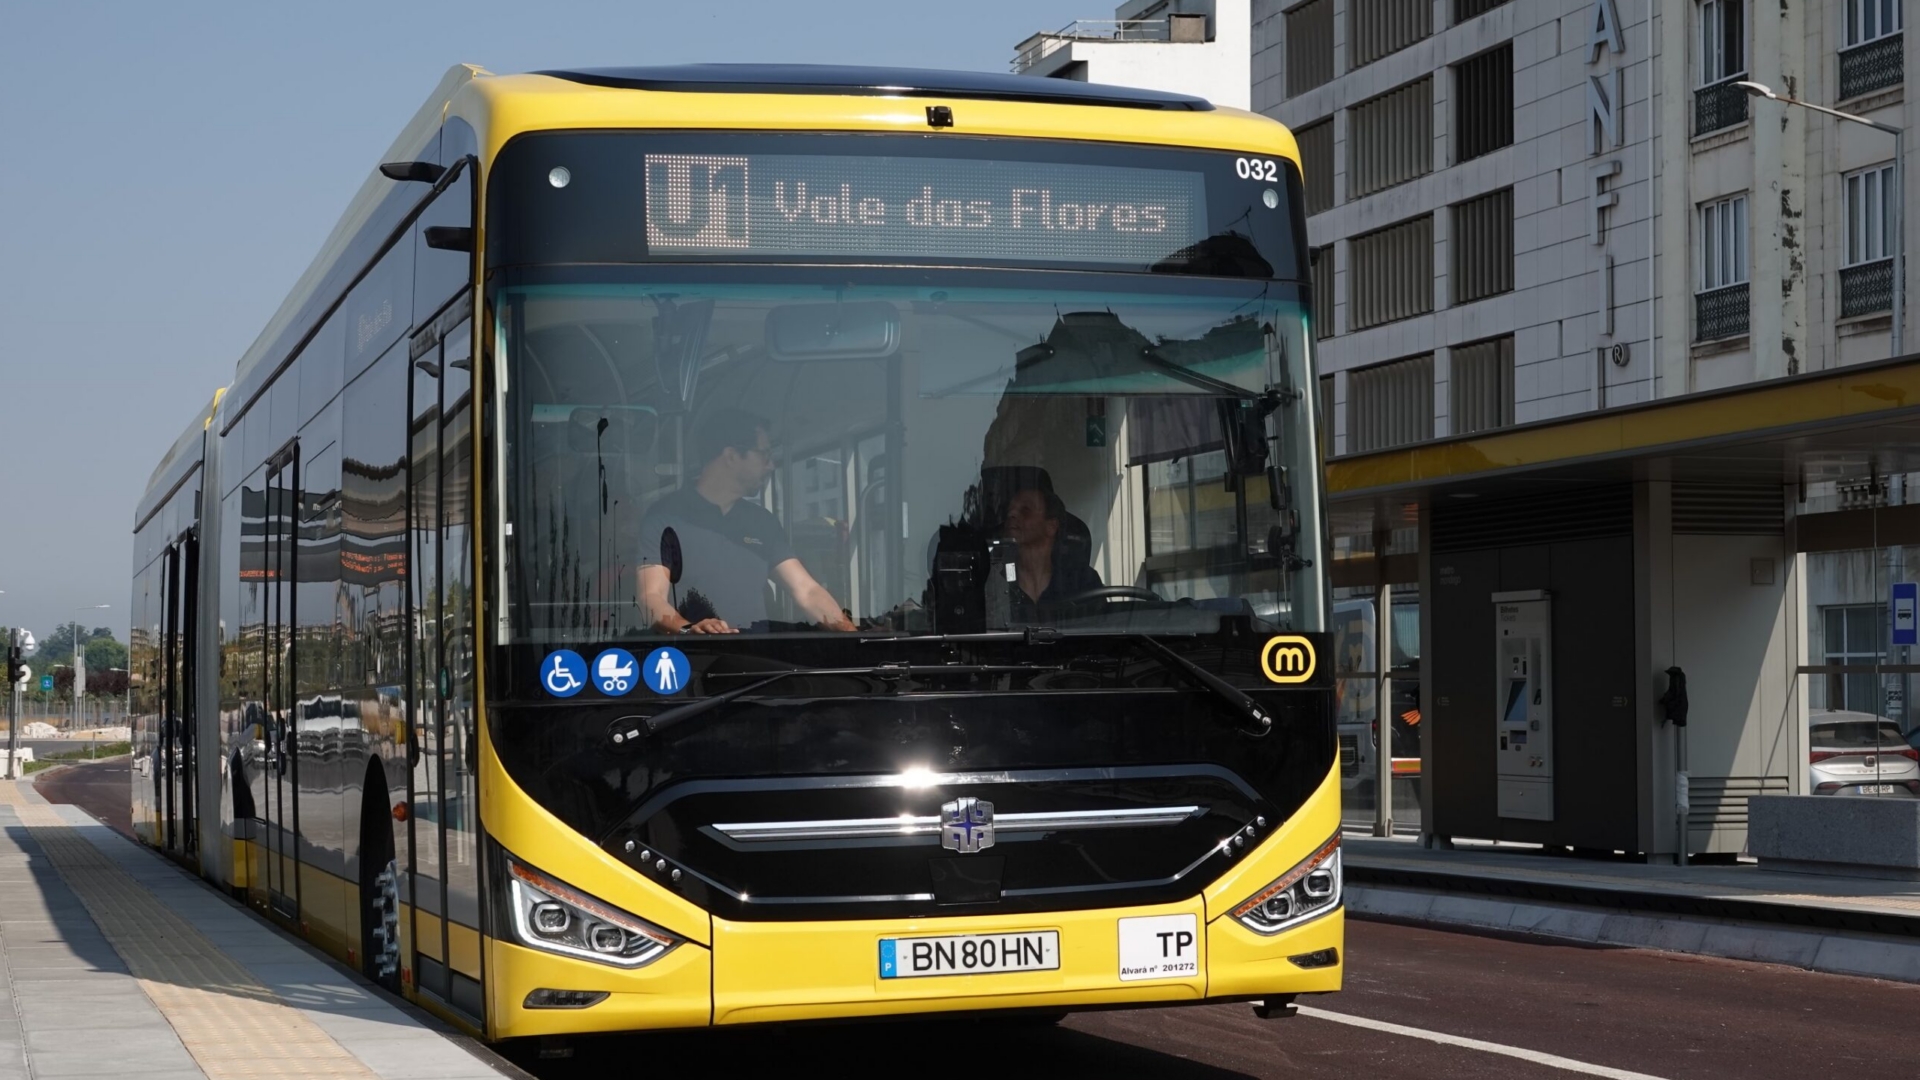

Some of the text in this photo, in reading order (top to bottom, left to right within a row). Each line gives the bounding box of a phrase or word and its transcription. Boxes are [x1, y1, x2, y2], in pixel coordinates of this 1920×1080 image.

[1235, 157, 1278, 182] 032
[649, 160, 1166, 243] U1 Vale das Flores
[1156, 931, 1193, 957] TP
[885, 962, 892, 972] P
[1121, 966, 1147, 975] Alvará
[1162, 962, 1195, 972] 201272
